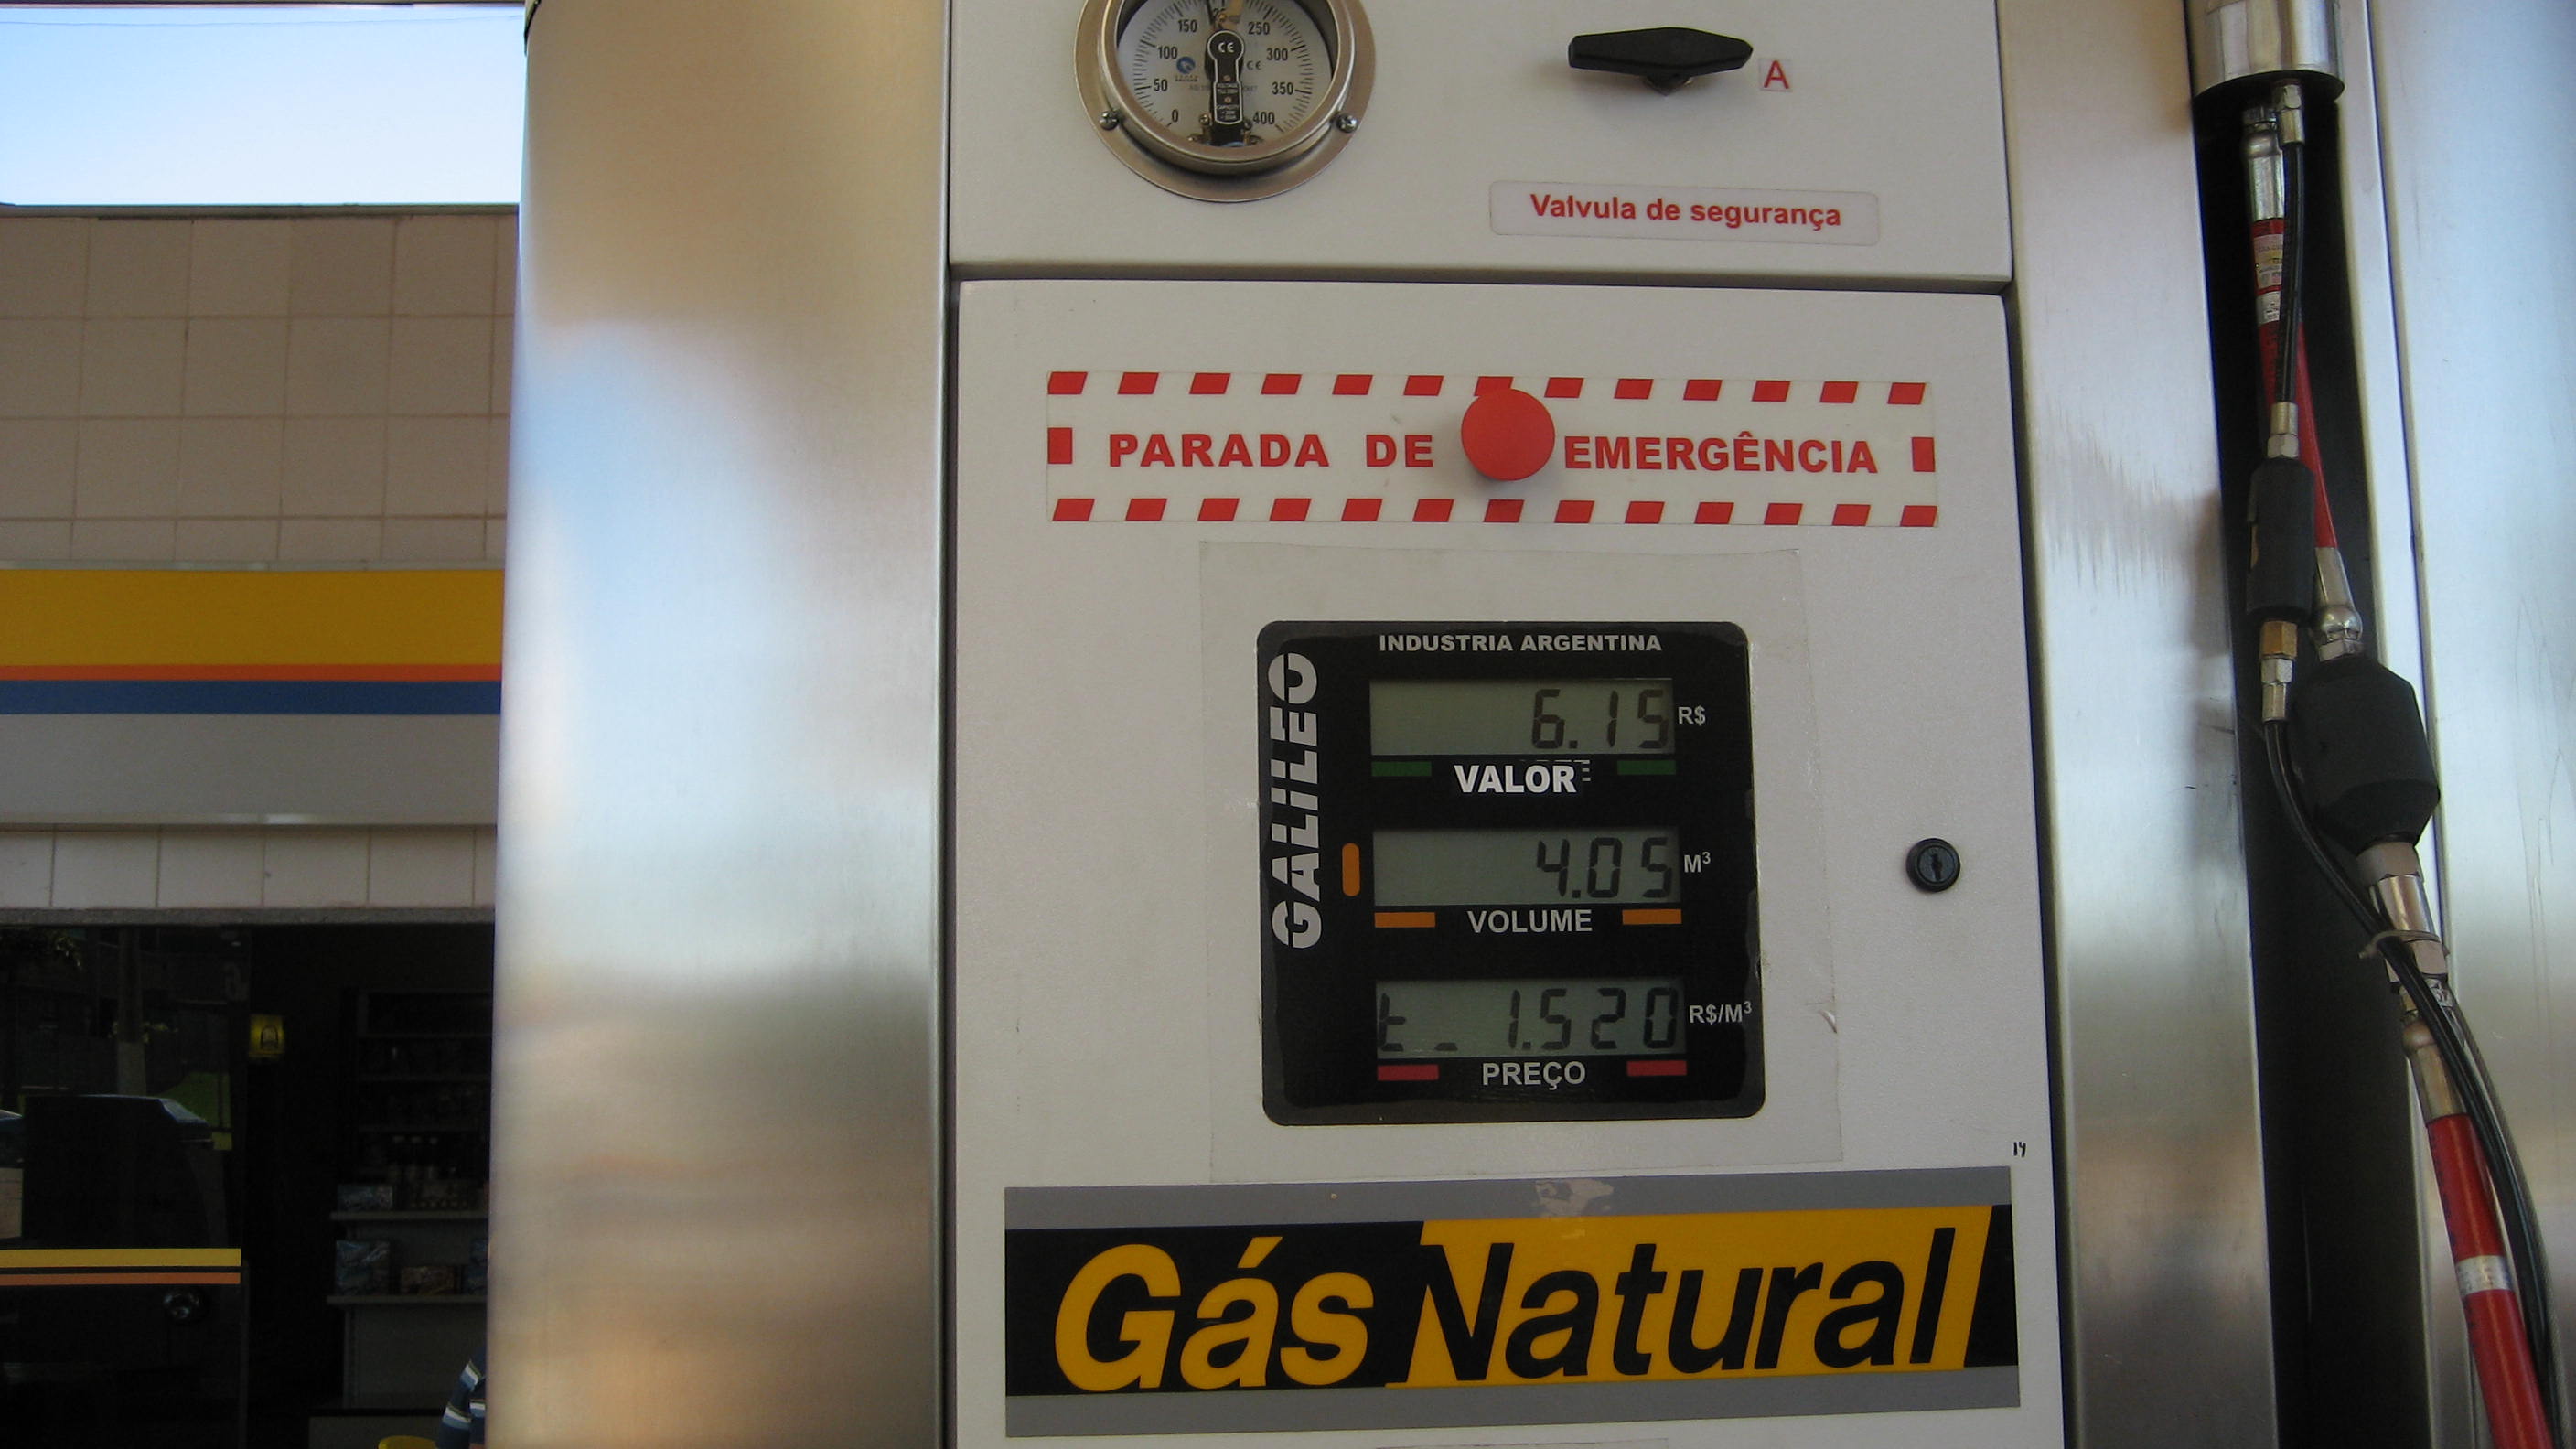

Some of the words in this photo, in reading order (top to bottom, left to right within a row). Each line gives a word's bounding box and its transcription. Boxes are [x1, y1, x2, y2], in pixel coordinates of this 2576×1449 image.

[1178, 19, 1197, 33] 150
[1248, 21, 1271, 35] 250
[1157, 46, 1178, 59] 100
[1218, 42, 1234, 53] CE
[1266, 48, 1288, 61] 300
[1246, 60, 1261, 70] CE
[1763, 60, 1790, 89] A
[1153, 79, 1168, 92] 50
[1272, 81, 1294, 96] 350
[1171, 109, 1179, 123] 0
[1252, 112, 1275, 125] 400
[1530, 193, 1637, 220] Valvula
[1647, 198, 1680, 221] de
[1690, 203, 1841, 231] segurança
[1110, 433, 1329, 467] PARADA
[1366, 435, 1434, 467] DE
[1564, 431, 1878, 474] EMERGÊNCIA
[1379, 634, 1514, 652] INDUSTRIA
[1519, 634, 1662, 651] ARGENTINA
[1531, 688, 1669, 750] 6.15
[1678, 704, 1706, 726] R$
[1454, 765, 1577, 793] VALOR
[1536, 836, 1673, 899] 4.05
[1466, 908, 1593, 934] VOLUME
[1508, 987, 1677, 1052] 1.520
[1482, 1060, 1586, 1091] PREÇO
[1054, 1236, 1373, 1392] Gás
[1385, 1227, 1957, 1390] Natural
